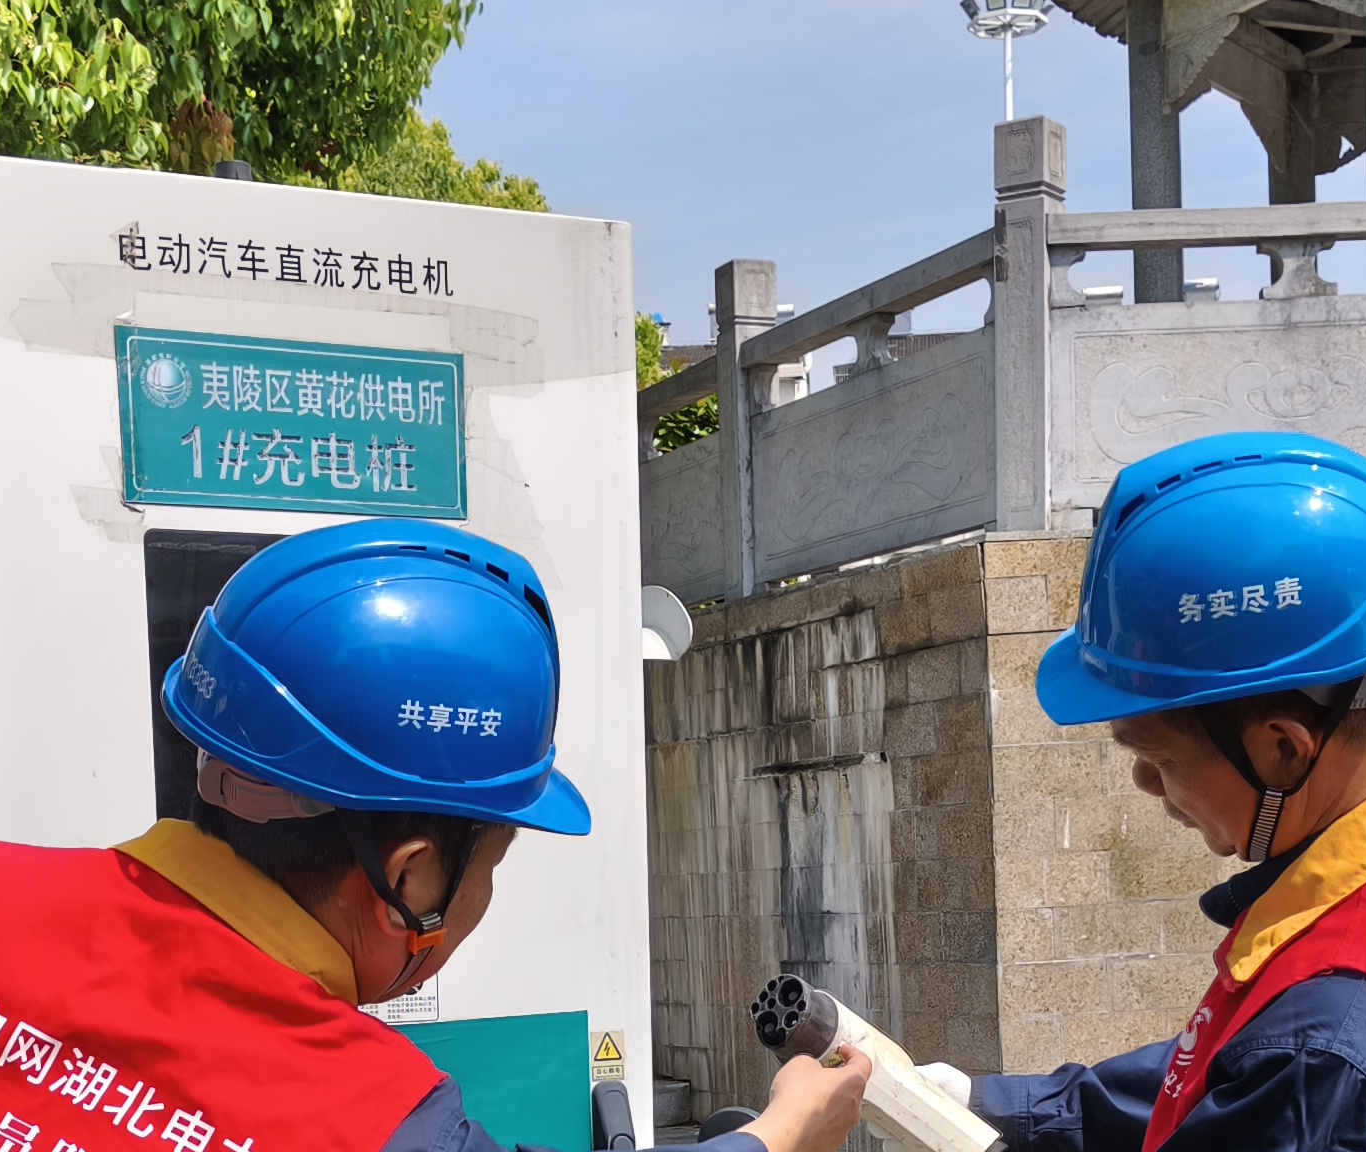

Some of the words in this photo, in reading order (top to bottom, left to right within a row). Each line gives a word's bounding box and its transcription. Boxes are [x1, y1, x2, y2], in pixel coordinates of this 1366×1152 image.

[118, 228, 454, 297] 电动汽车直流充电机
[199, 361, 445, 426] 夷陵区黄花供电所
[181, 424, 417, 493] 1#充电桩
[1178, 577, 1303, 623] 务实尽责
[398, 700, 502, 737] 共享平安
